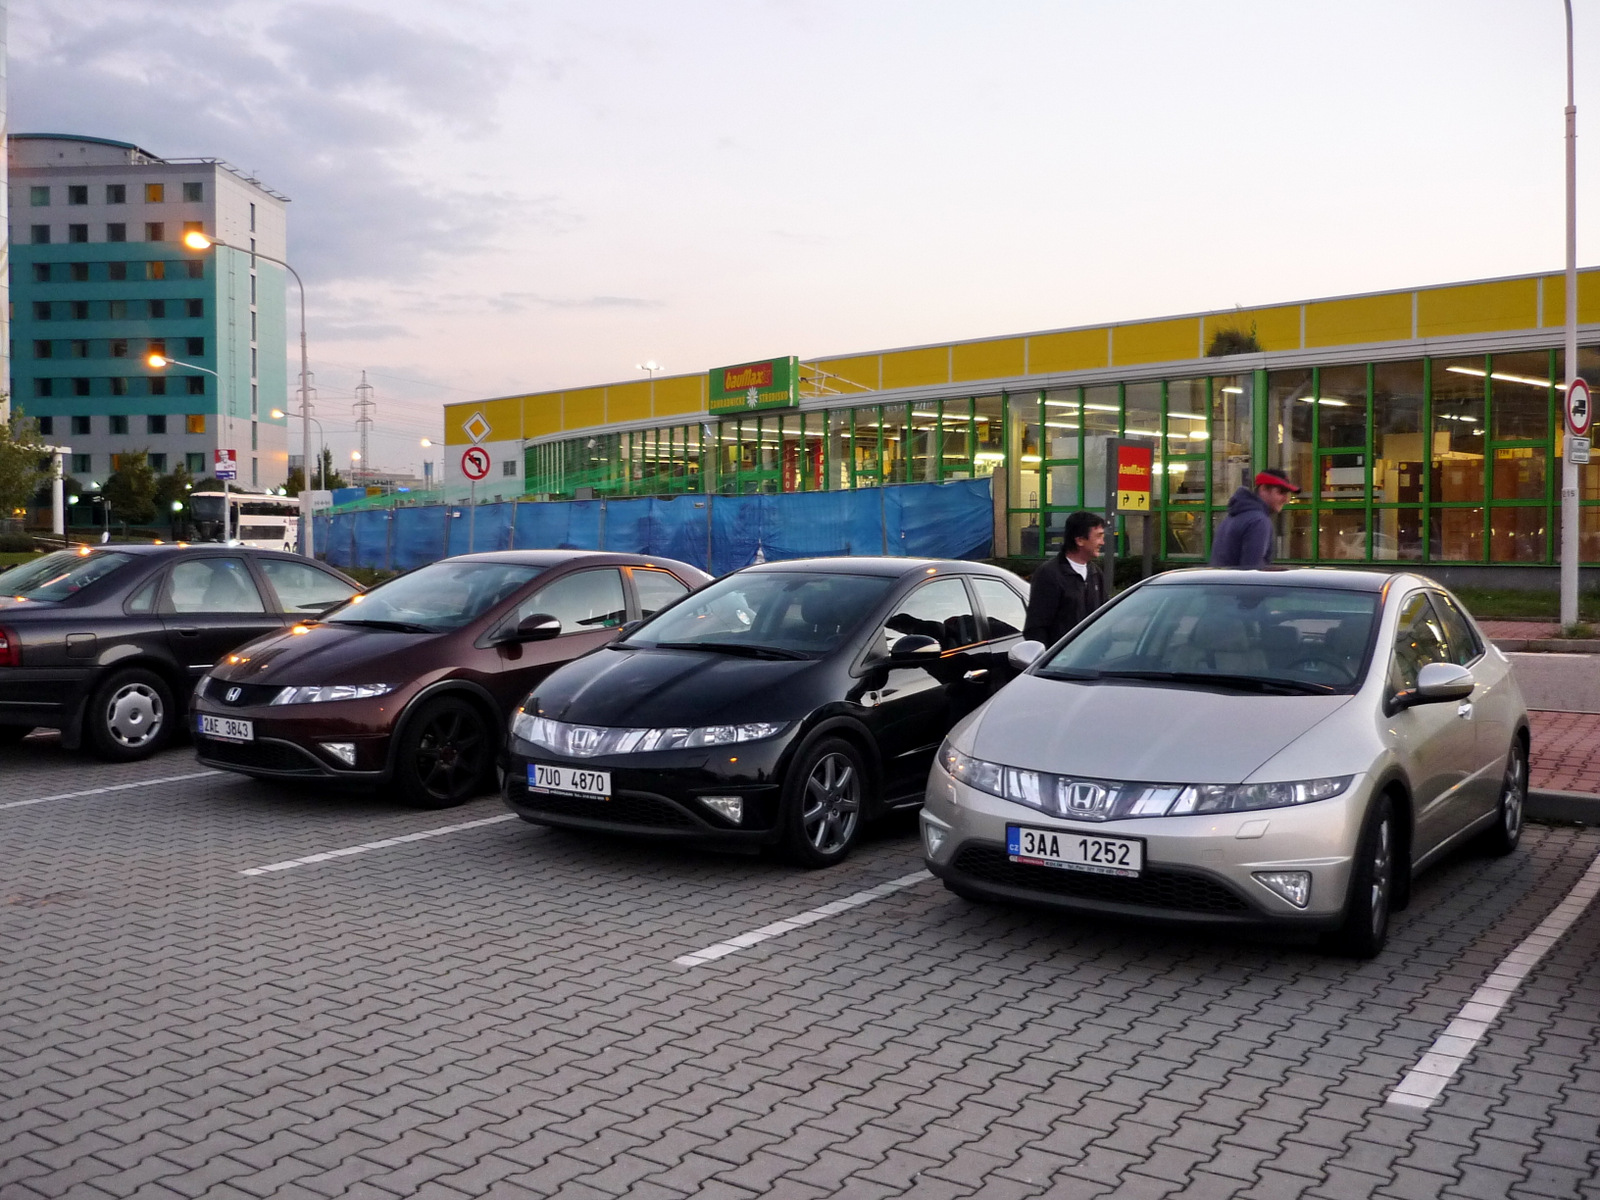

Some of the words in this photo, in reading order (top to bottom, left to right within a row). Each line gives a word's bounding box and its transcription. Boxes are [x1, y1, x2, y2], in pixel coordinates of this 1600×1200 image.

[204, 717, 220, 733] 2AE
[225, 720, 249, 737] 3843
[571, 771, 604, 792] 4870
[1024, 832, 1060, 857] 3AA
[1079, 839, 1130, 866] 1252
